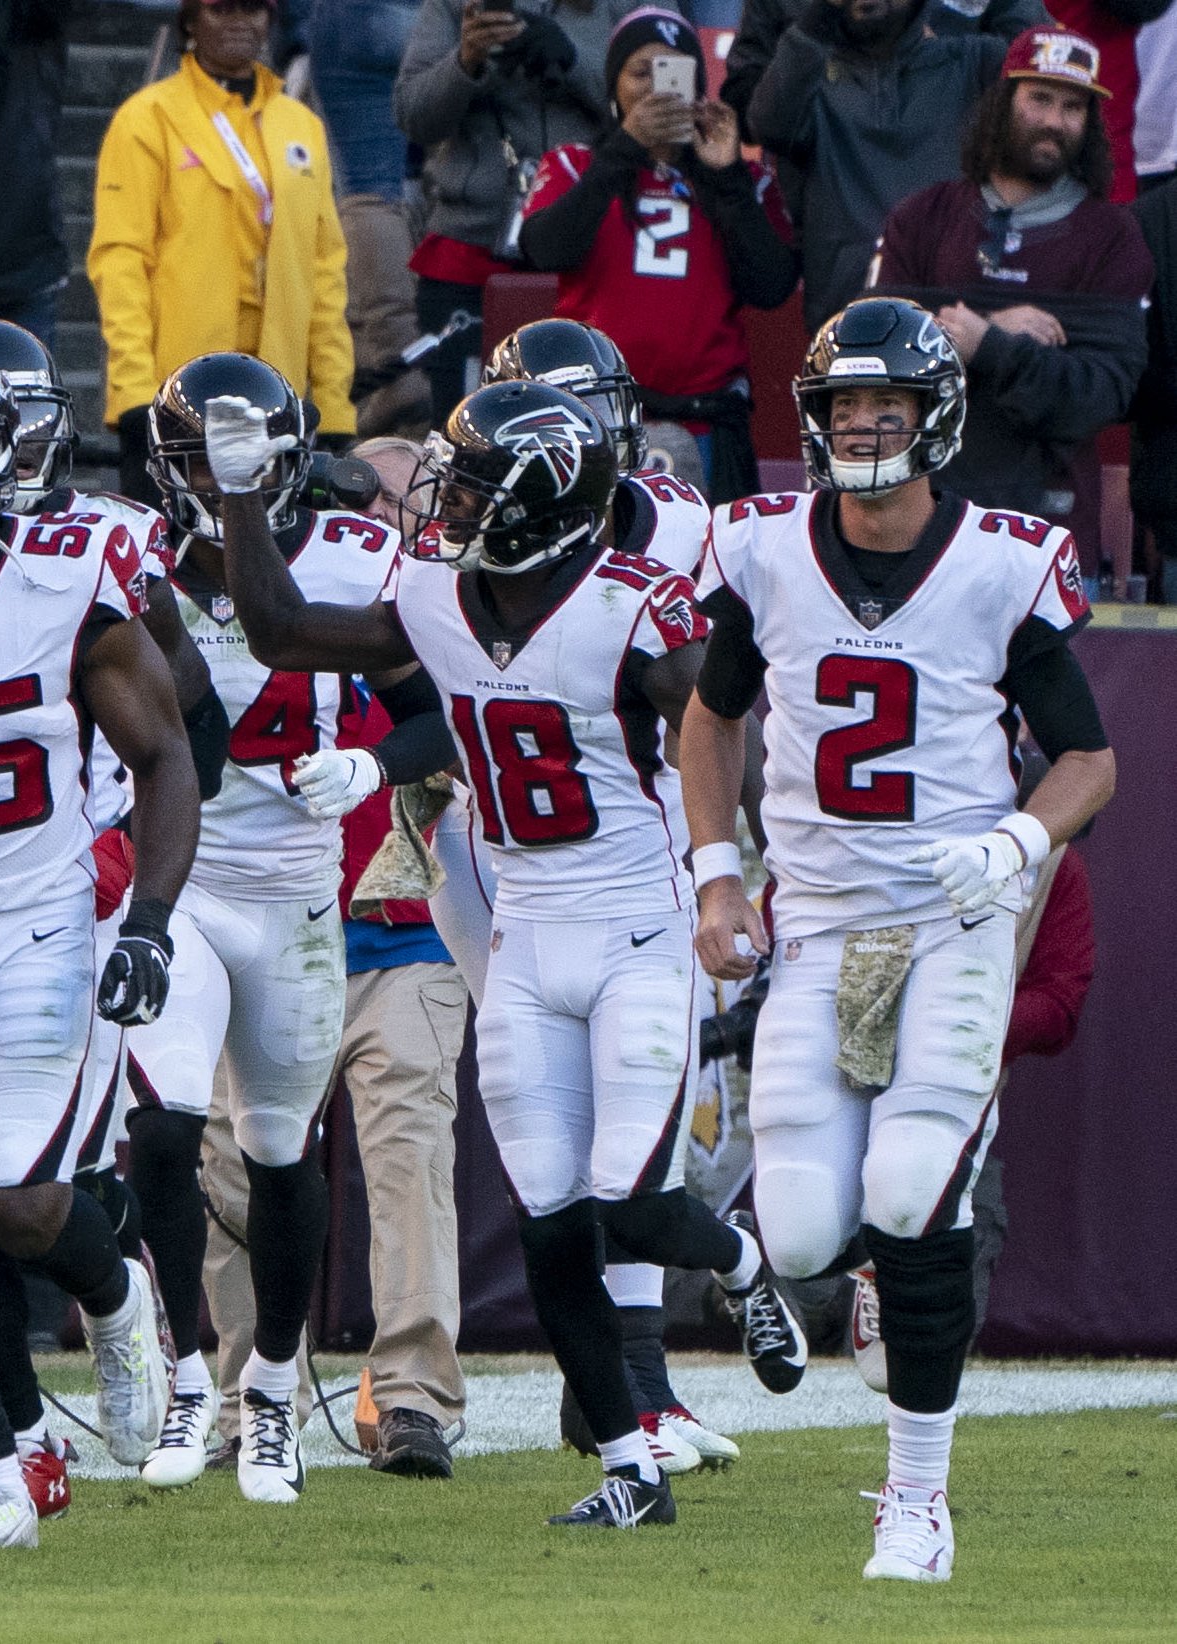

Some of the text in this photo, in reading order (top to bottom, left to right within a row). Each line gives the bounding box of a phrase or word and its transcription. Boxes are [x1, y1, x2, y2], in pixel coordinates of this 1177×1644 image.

[634, 197, 691, 278] 2
[729, 494, 799, 525] 2
[978, 511, 1054, 548] 2
[195, 636, 246, 645] ALCON
[835, 637, 904, 650] FALCONS
[476, 680, 530, 692] FALCONS
[227, 670, 321, 797] 4
[814, 653, 918, 822] 2
[449, 692, 600, 848] 18
